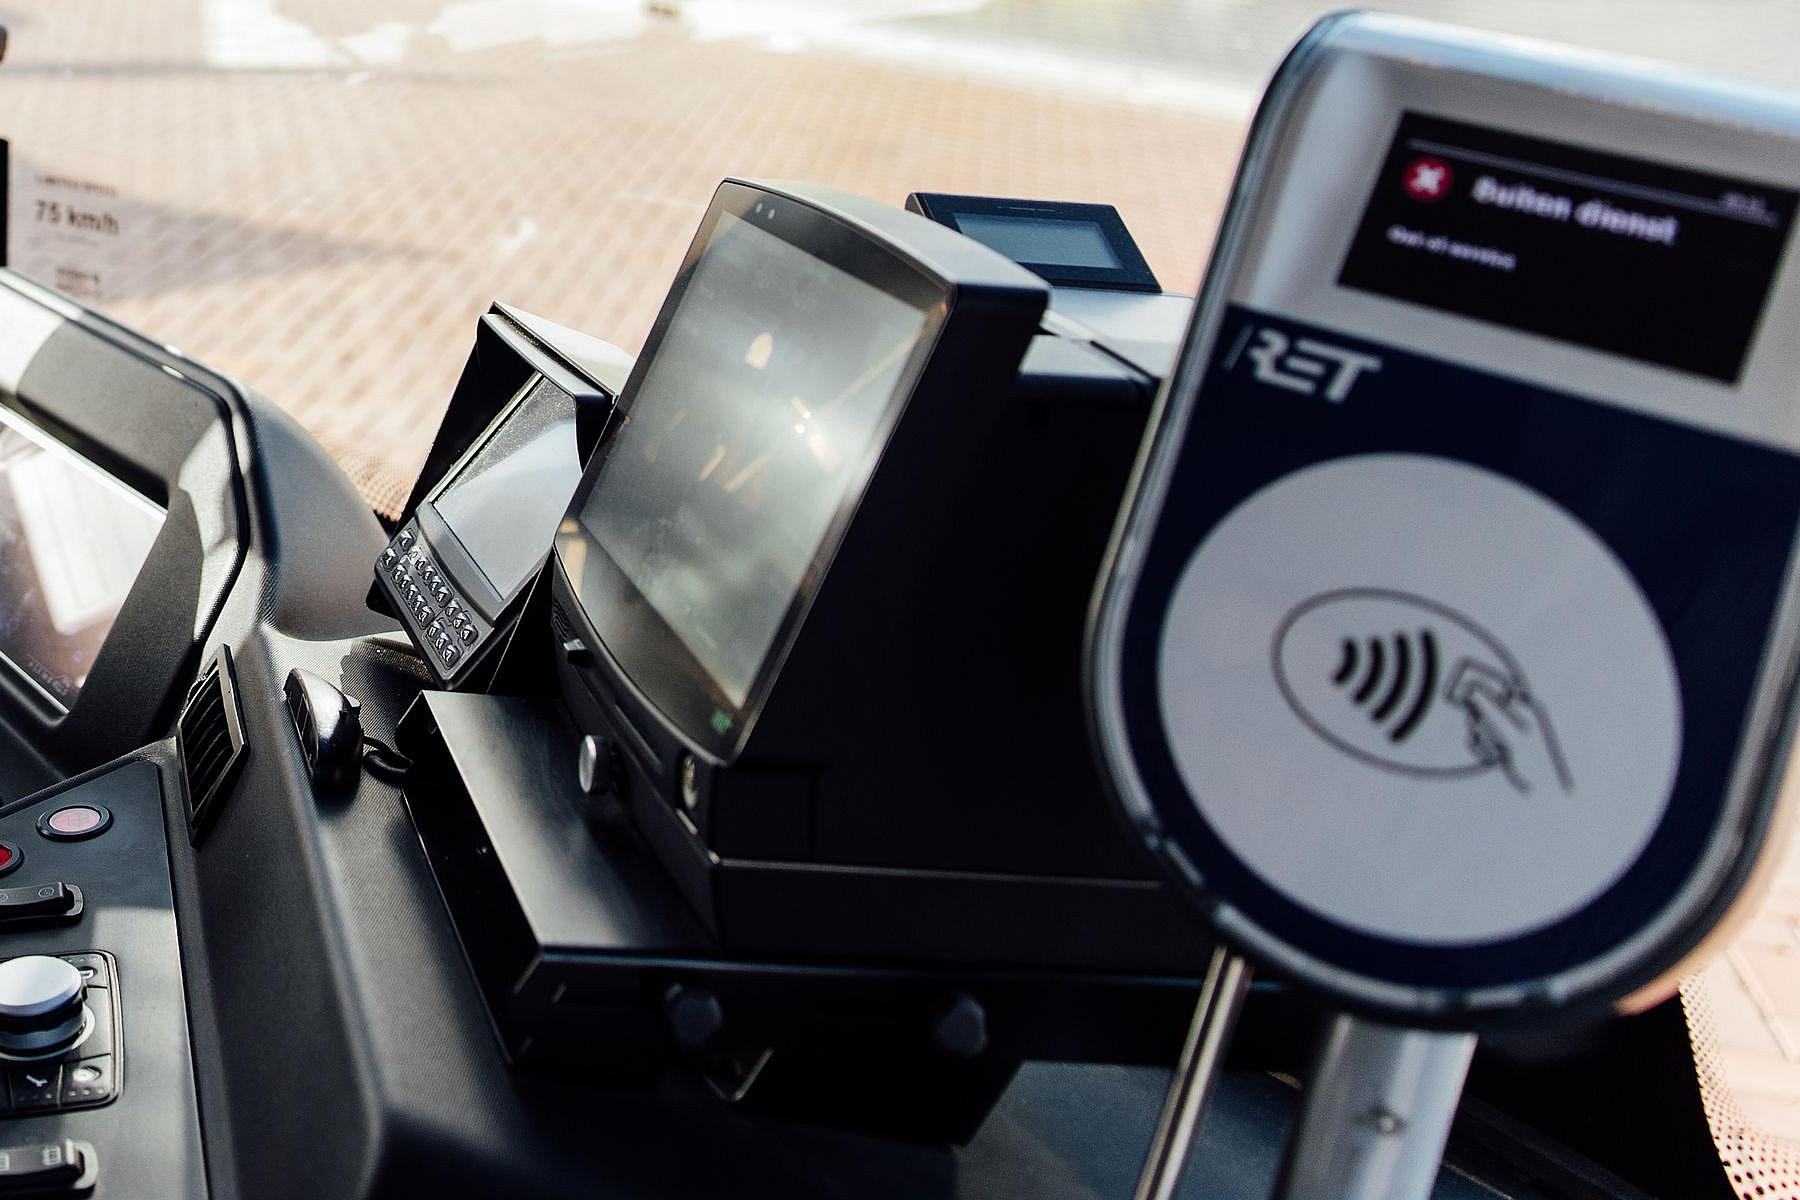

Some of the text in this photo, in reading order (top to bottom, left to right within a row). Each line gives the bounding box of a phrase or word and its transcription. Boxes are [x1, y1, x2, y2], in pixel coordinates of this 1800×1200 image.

[35, 199, 119, 236] 75 km/h
[1471, 174, 1572, 221] Buiten
[1574, 200, 1679, 245] dienst
[1223, 324, 1384, 404] RET
